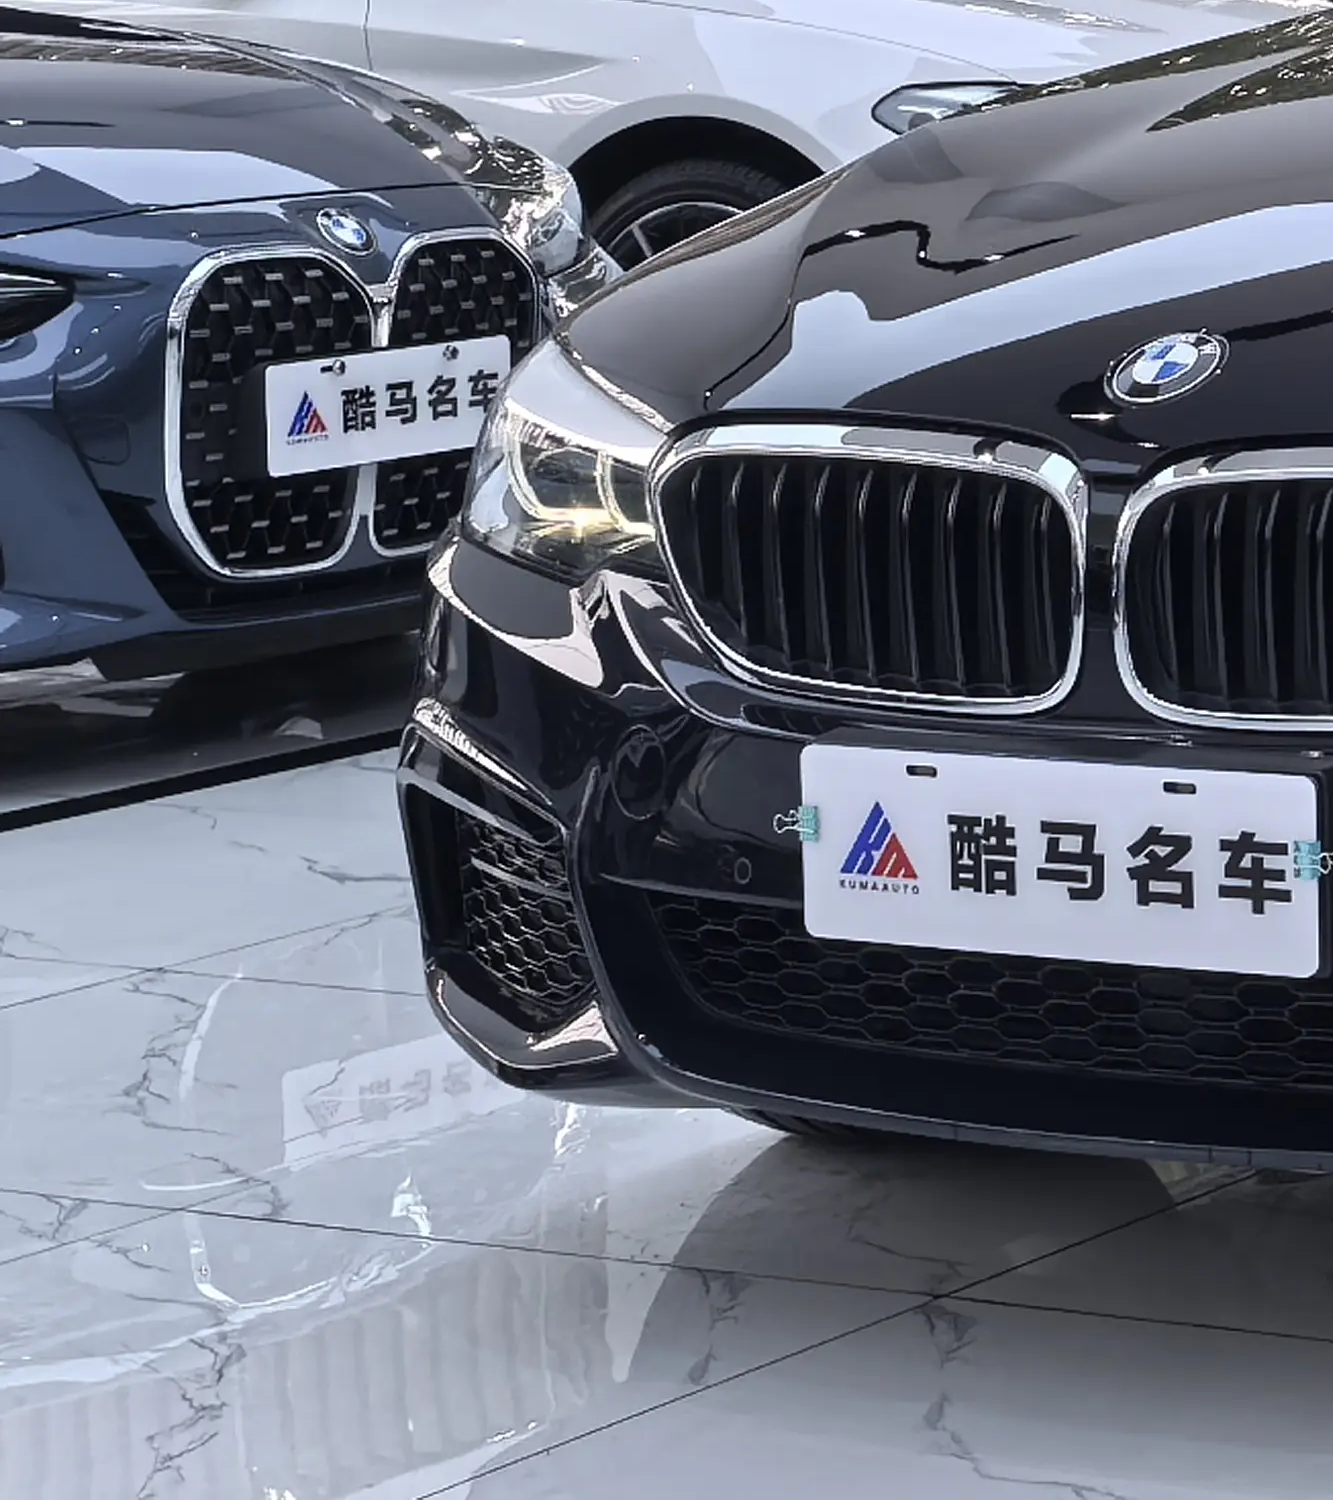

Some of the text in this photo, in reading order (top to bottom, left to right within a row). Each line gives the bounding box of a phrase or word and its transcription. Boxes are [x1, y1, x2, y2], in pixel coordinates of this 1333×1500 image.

[341, 368, 499, 434] 酷马名车
[946, 814, 1293, 915] 酷马名车
